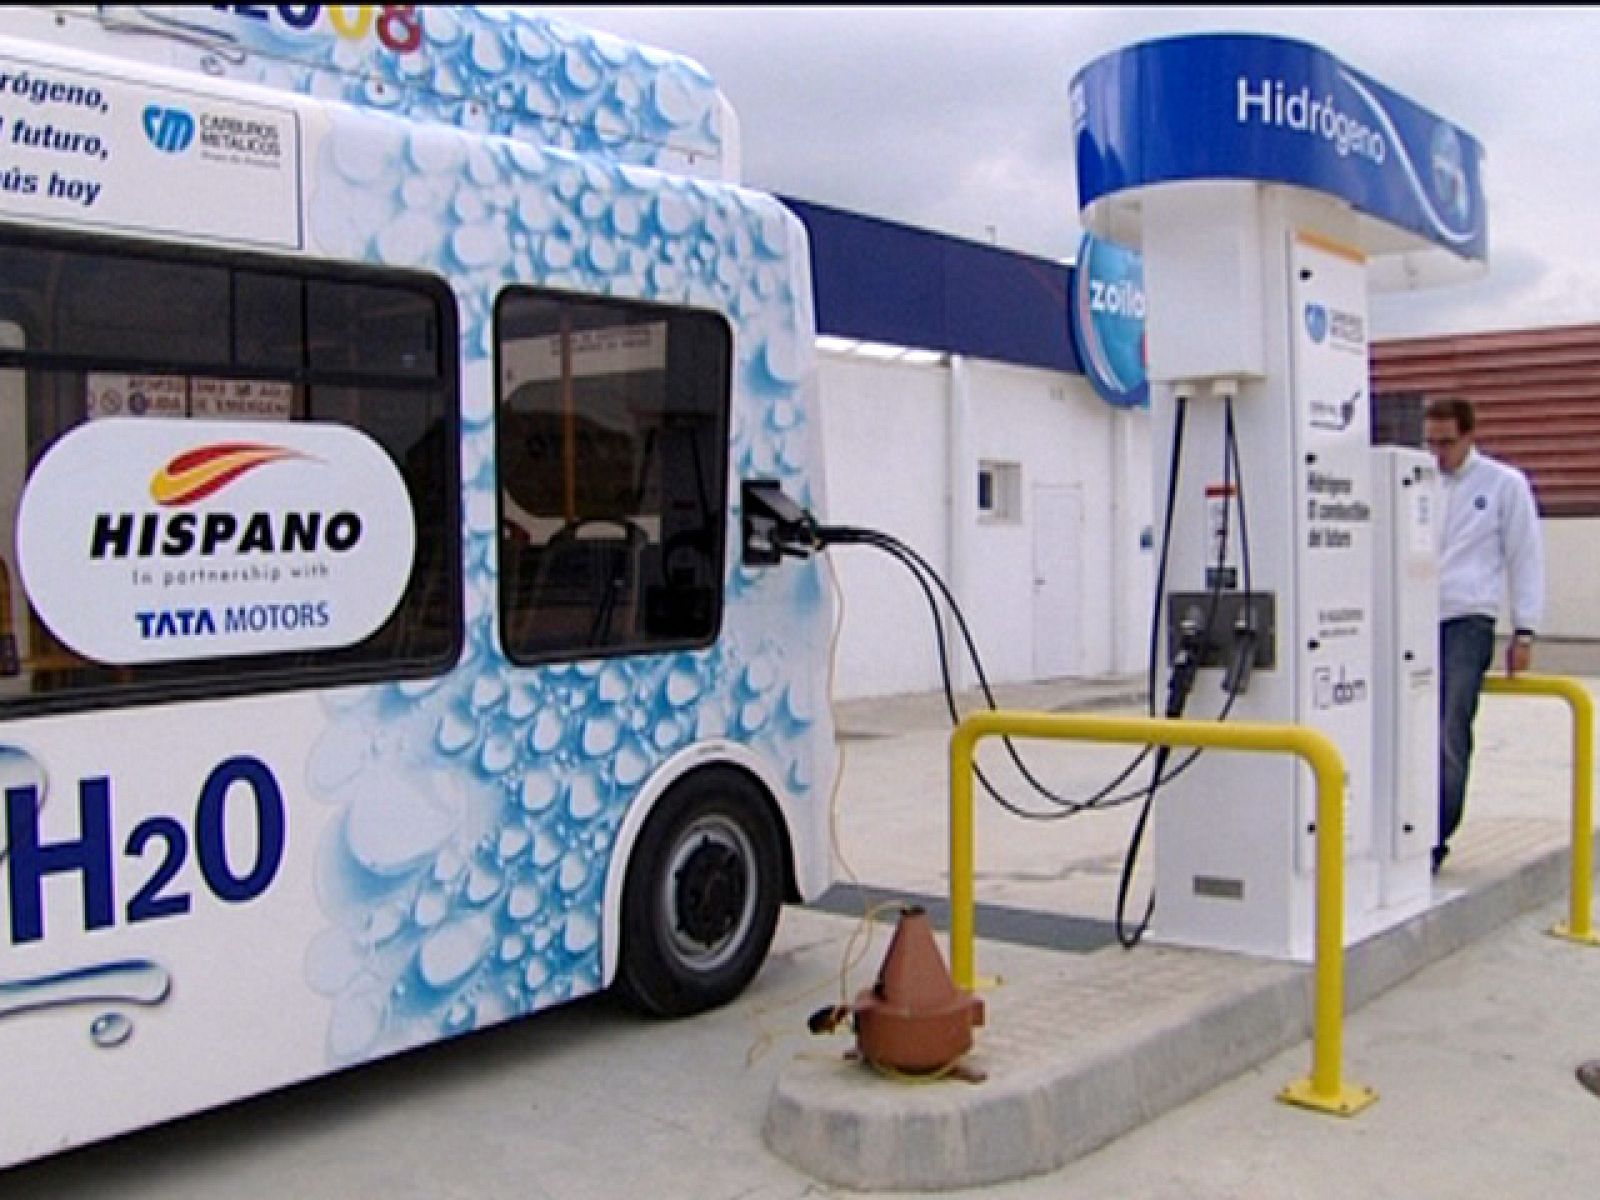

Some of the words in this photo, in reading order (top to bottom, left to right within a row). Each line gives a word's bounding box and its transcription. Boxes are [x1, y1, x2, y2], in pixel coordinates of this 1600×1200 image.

[12, 118, 109, 161] futuro,
[1236, 76, 1386, 165] Hidrógeno
[47, 170, 102, 208] hoy
[90, 511, 361, 559] HISPANO
[163, 565, 281, 588] partnership
[291, 562, 329, 578] with
[135, 609, 216, 639] TATA
[224, 601, 330, 633] MOTORS
